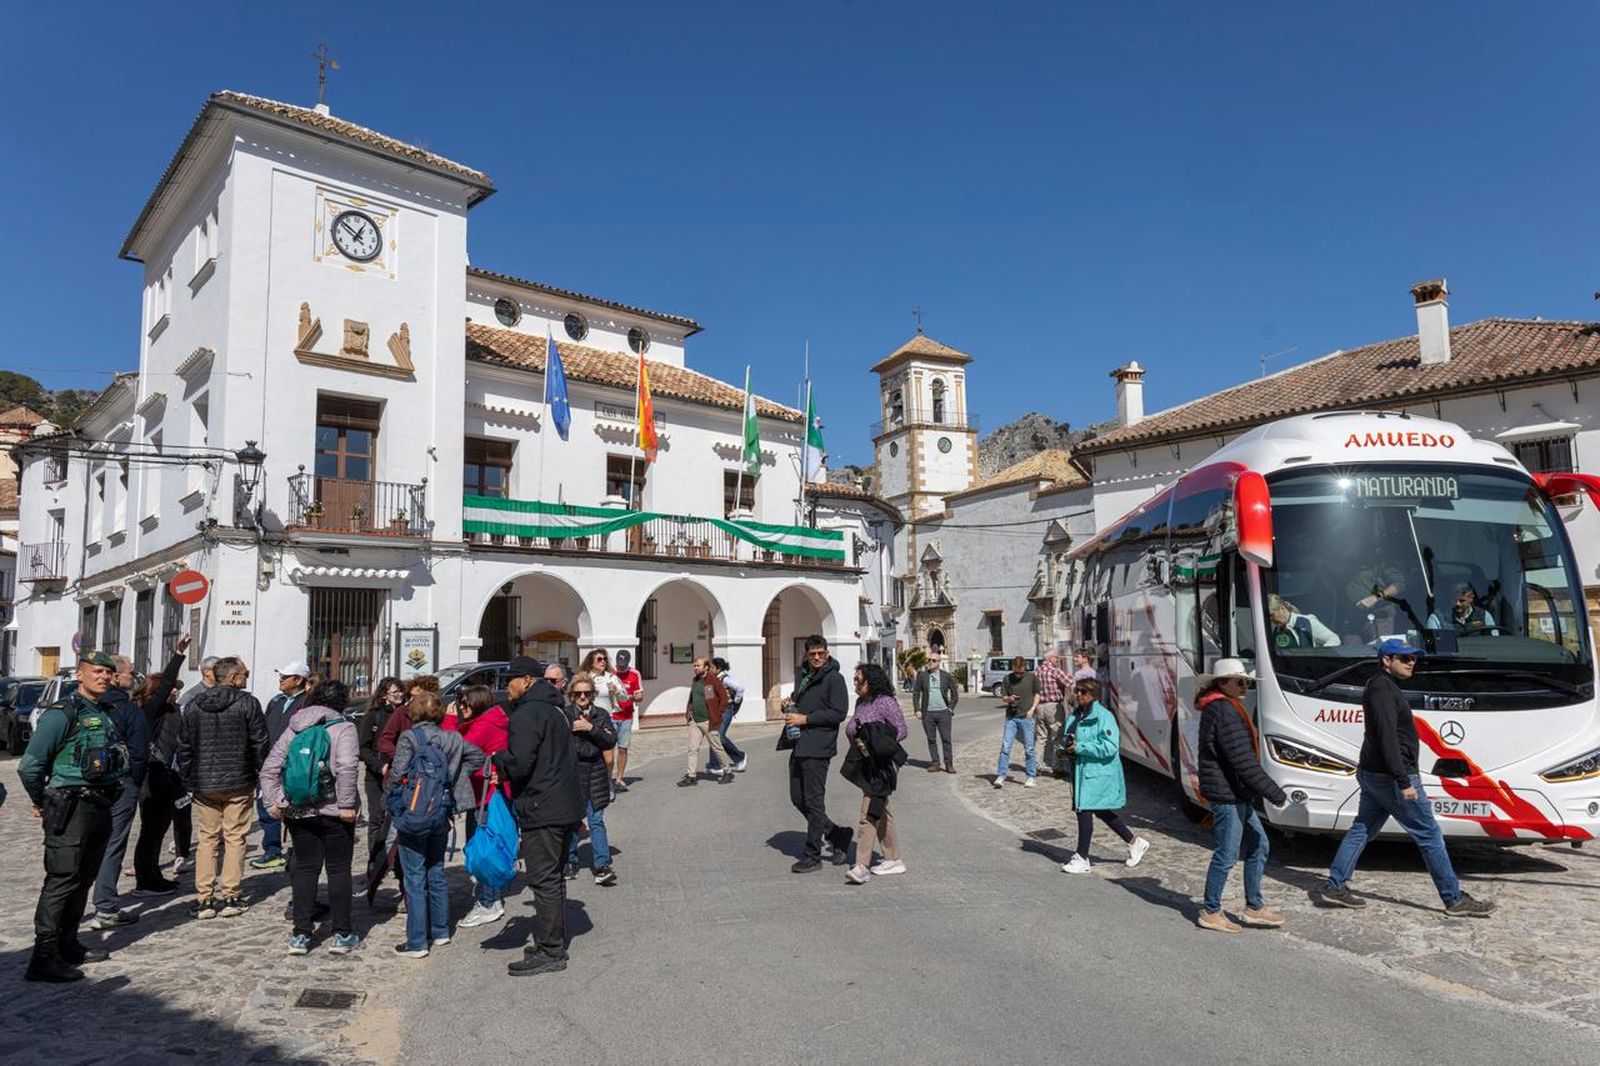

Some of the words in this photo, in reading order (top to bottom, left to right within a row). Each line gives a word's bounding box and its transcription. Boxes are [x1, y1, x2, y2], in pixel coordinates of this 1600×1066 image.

[1344, 432, 1455, 448] AMUEDO
[1356, 476, 1458, 499] NATURANDA
[1314, 709, 1363, 723] AMUE
[1434, 801, 1459, 814] 957
[1463, 802, 1489, 815] NFT
